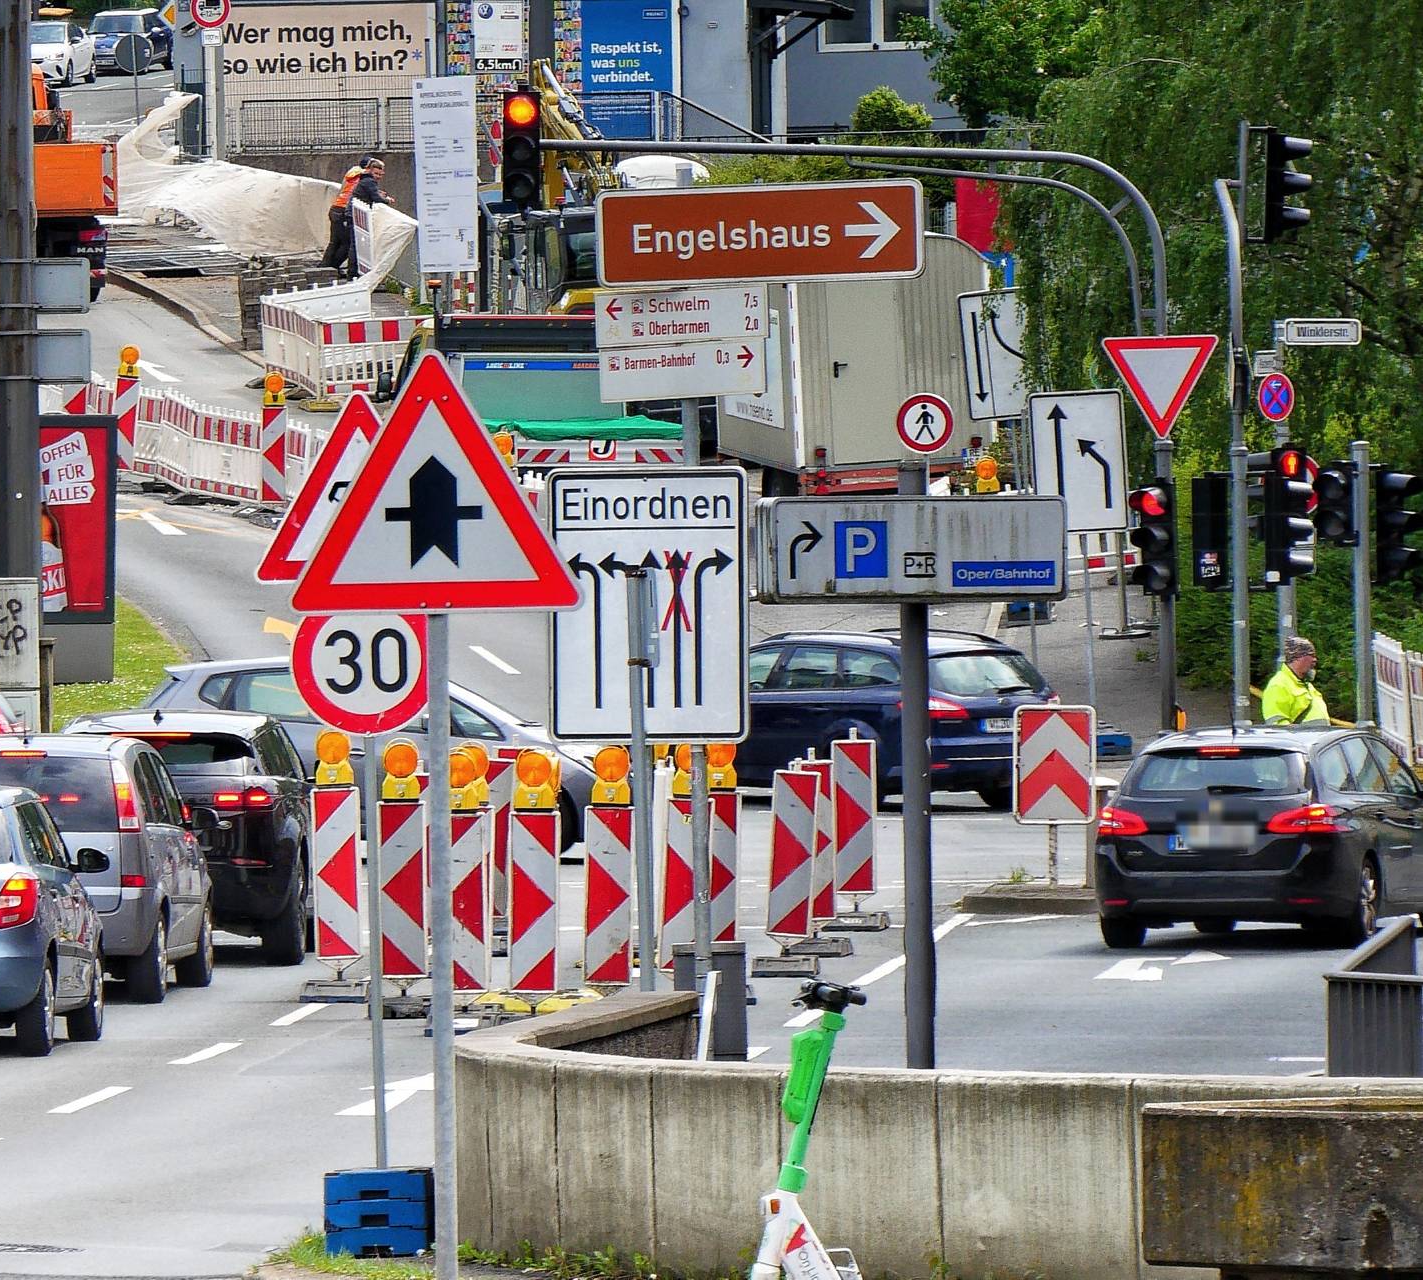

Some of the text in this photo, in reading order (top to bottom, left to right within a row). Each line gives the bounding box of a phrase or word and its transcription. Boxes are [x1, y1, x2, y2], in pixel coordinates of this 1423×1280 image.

[224, 19, 412, 48] Wer mag mich,
[591, 41, 662, 56] Respekt ist,
[223, 49, 408, 75] so wie ich bin?
[477, 59, 513, 71] 6,5km
[591, 59, 640, 68] was uns
[591, 70, 654, 84] verbindet.
[632, 219, 831, 260] Engelshaus
[648, 292, 759, 313] Schwelm 7,5
[649, 316, 759, 335] Oberbarmen 2,0
[1297, 327, 1350, 338] Winklerstr.
[624, 348, 730, 371] Barmen-Bahnhof 0,3
[41, 439, 81, 464] OFFEN
[57, 464, 85, 482] FÜR
[48, 485, 88, 502] ALLES
[562, 488, 731, 520] Einordnen
[846, 527, 1051, 581] P P+R Oper/Bahnhof
[325, 628, 408, 695] 30
